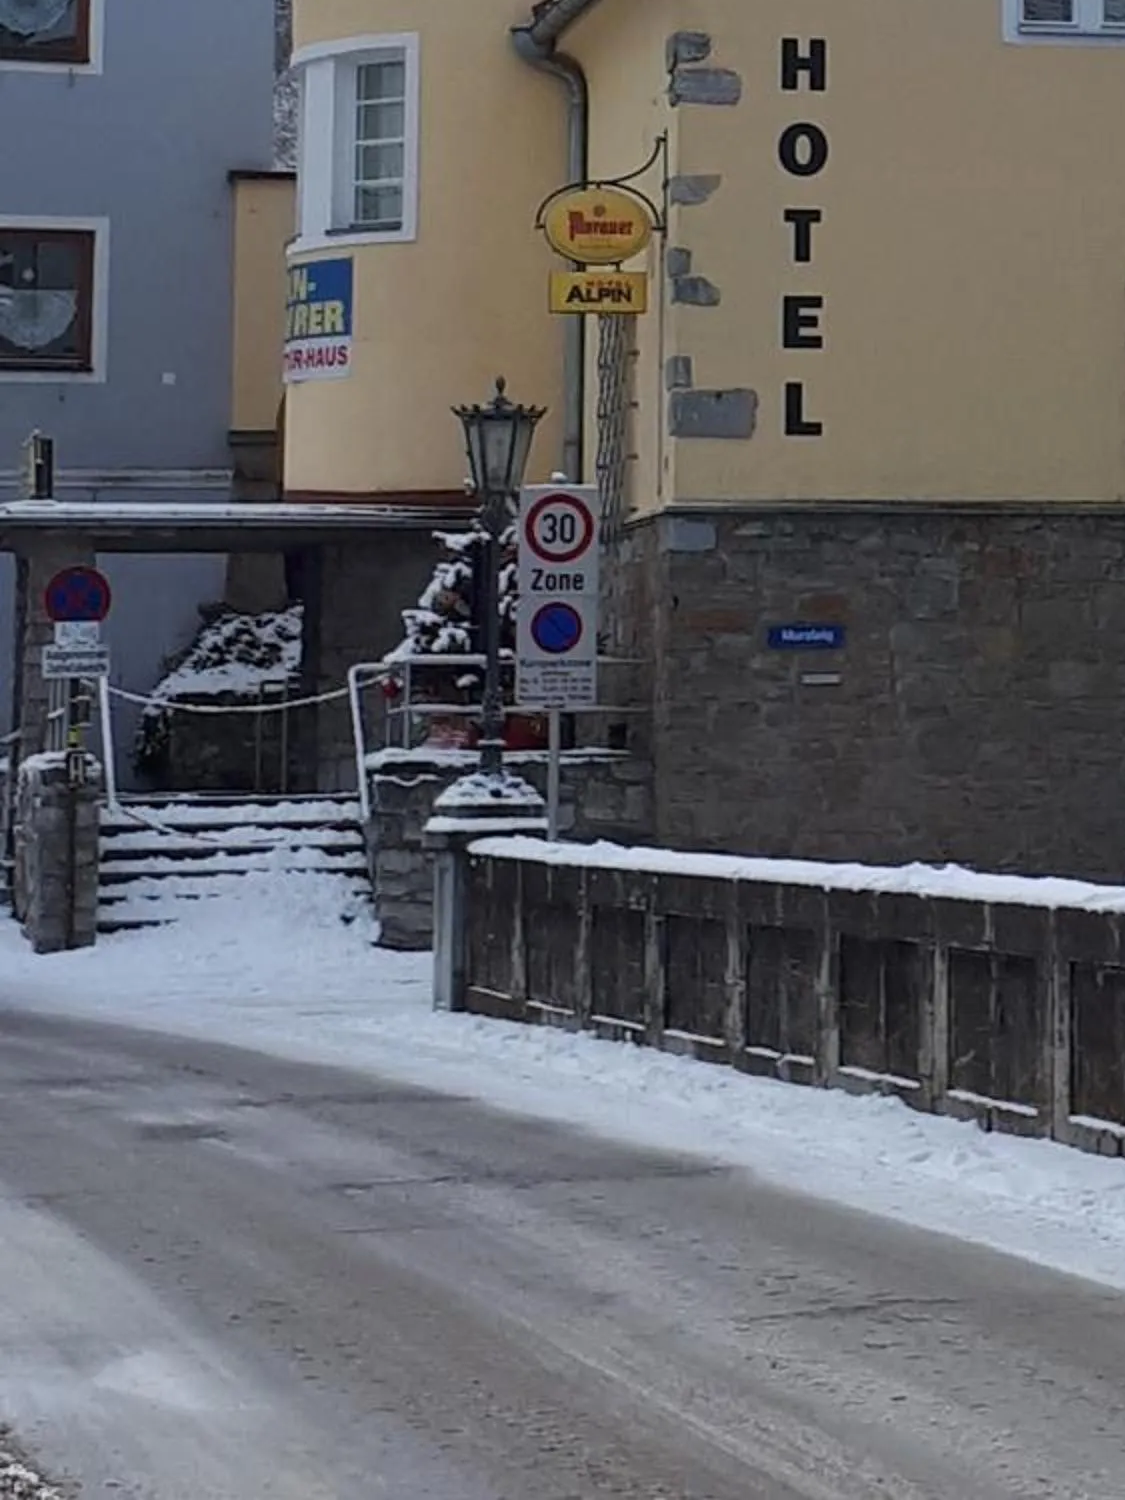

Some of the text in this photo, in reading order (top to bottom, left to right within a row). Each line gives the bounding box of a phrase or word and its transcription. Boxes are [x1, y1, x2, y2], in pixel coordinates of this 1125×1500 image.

[778, 37, 829, 437] HOTEL
[565, 285, 632, 304] ALPIN
[542, 513, 576, 545] 30
[531, 568, 584, 592] Zone
